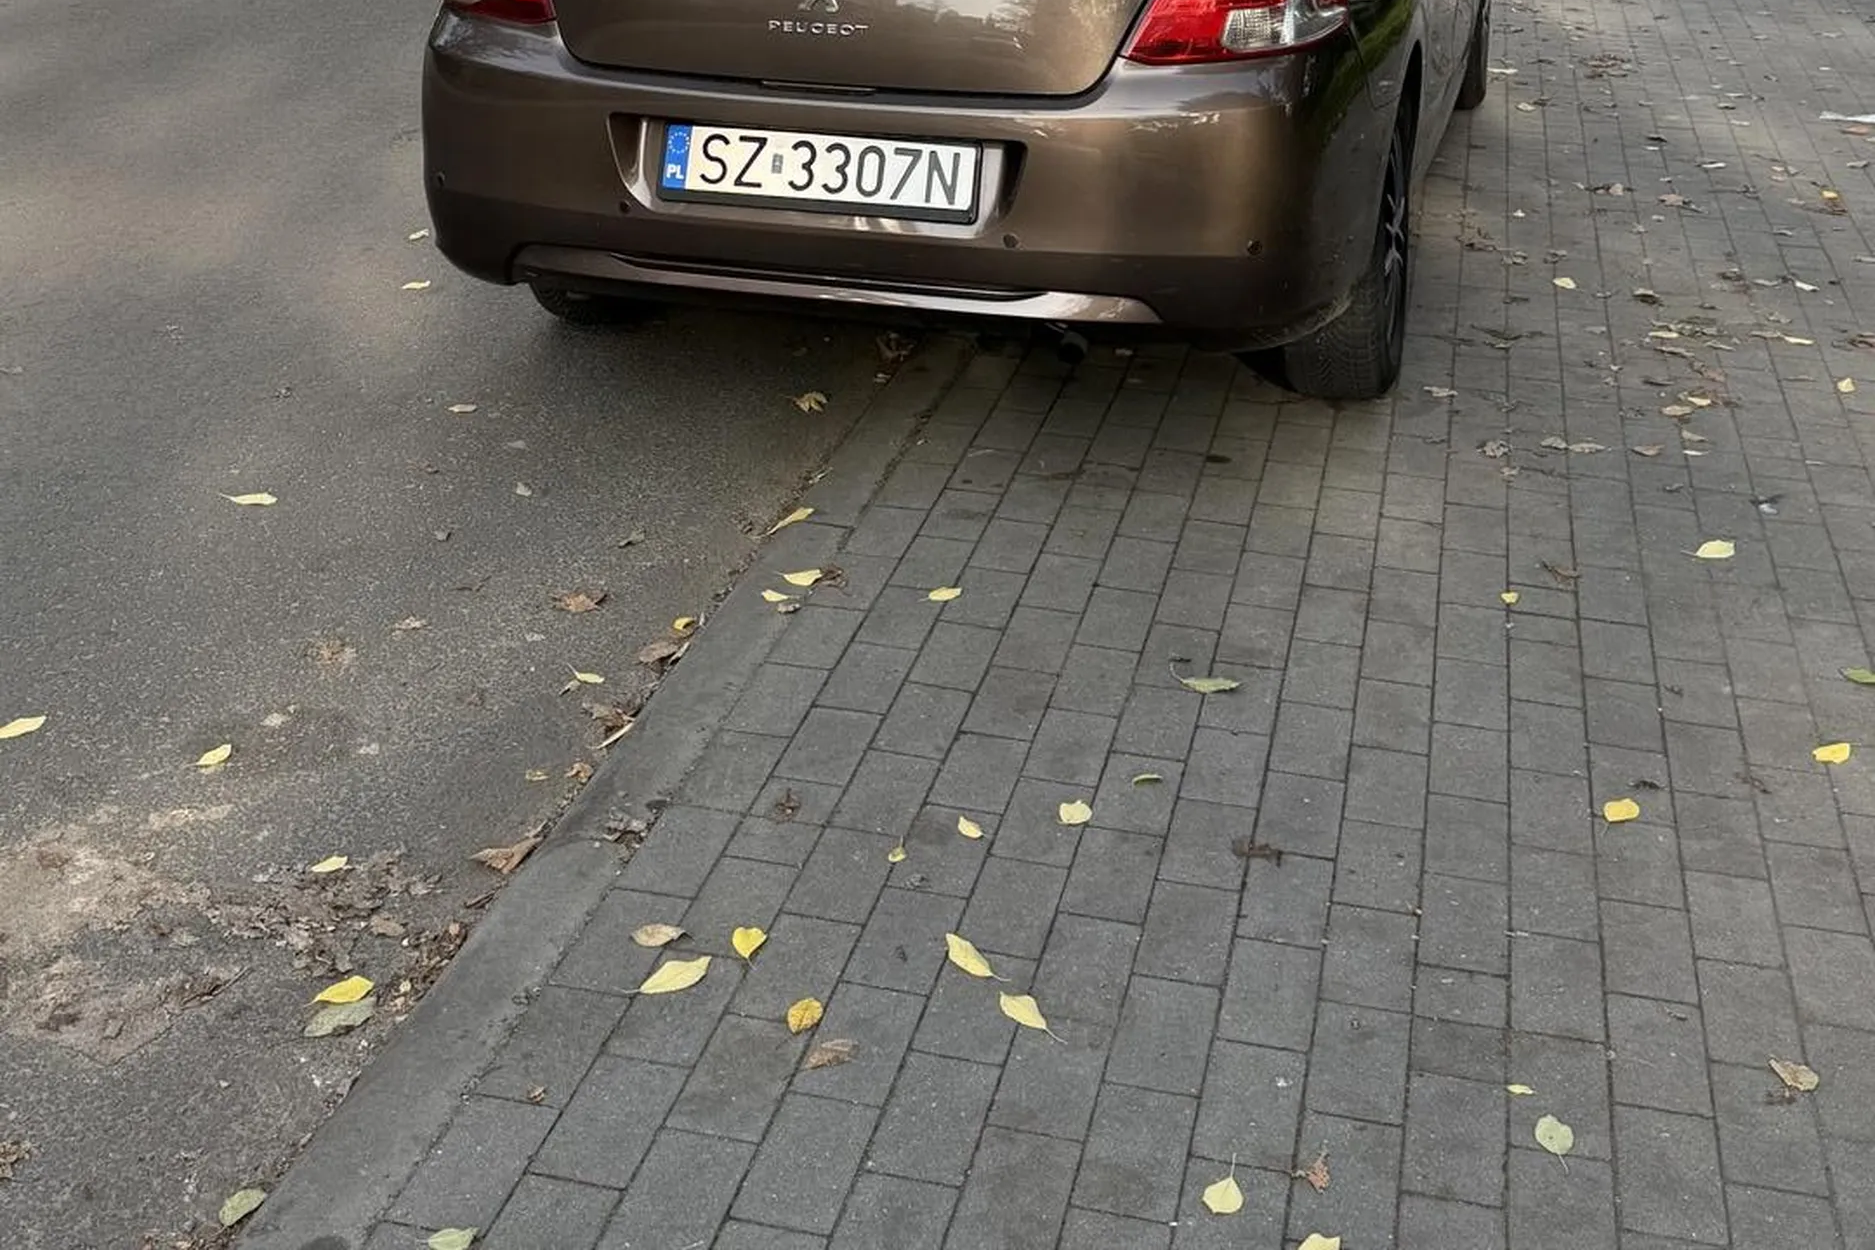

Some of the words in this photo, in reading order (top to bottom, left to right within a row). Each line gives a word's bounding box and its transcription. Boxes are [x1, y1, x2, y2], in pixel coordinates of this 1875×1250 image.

[768, 19, 869, 36] PEUGEOT
[666, 163, 685, 180] PL
[788, 139, 961, 206] 3307N
